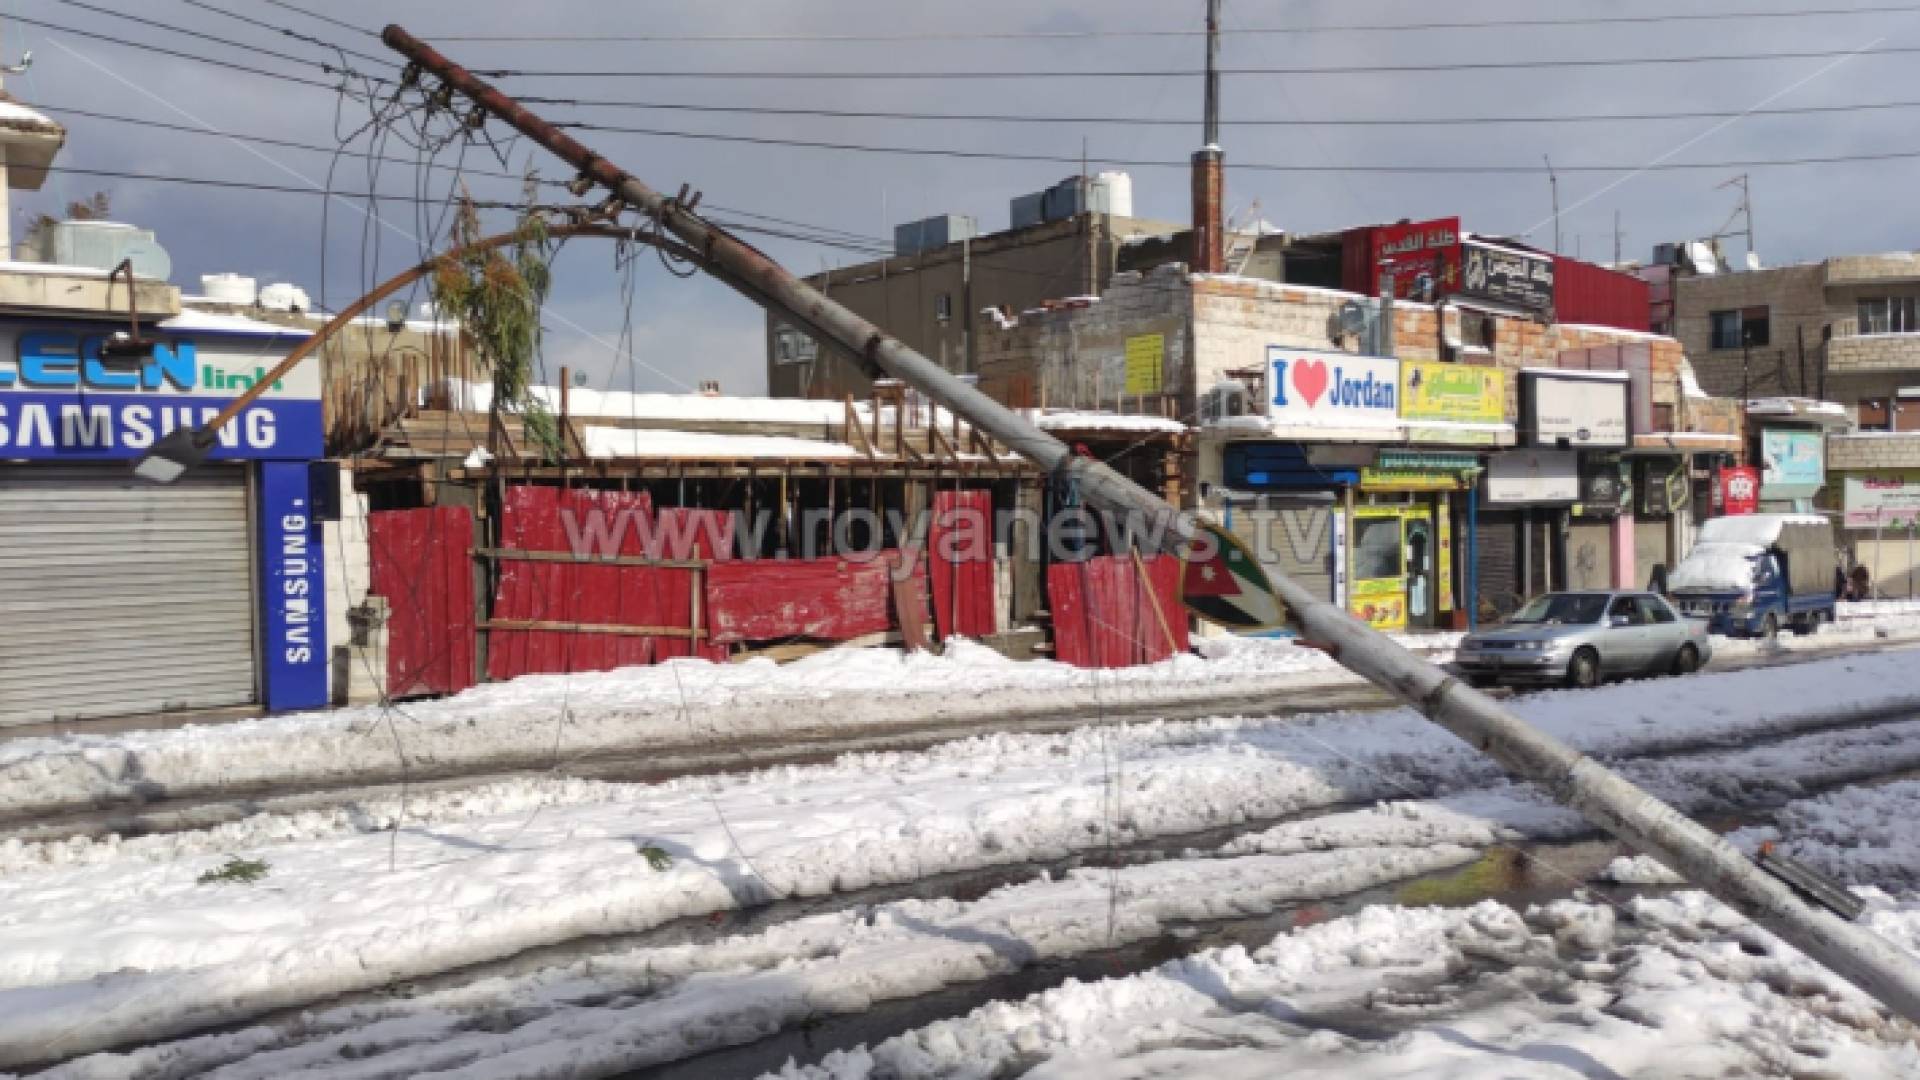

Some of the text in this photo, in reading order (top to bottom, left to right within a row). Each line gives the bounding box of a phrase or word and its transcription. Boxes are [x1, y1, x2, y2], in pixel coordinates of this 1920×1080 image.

[1272, 359, 1288, 406] I
[1329, 366, 1395, 409] Jordan
[0, 403, 277, 449] AMSUNG
[283, 514, 310, 664] SAMSUNG
